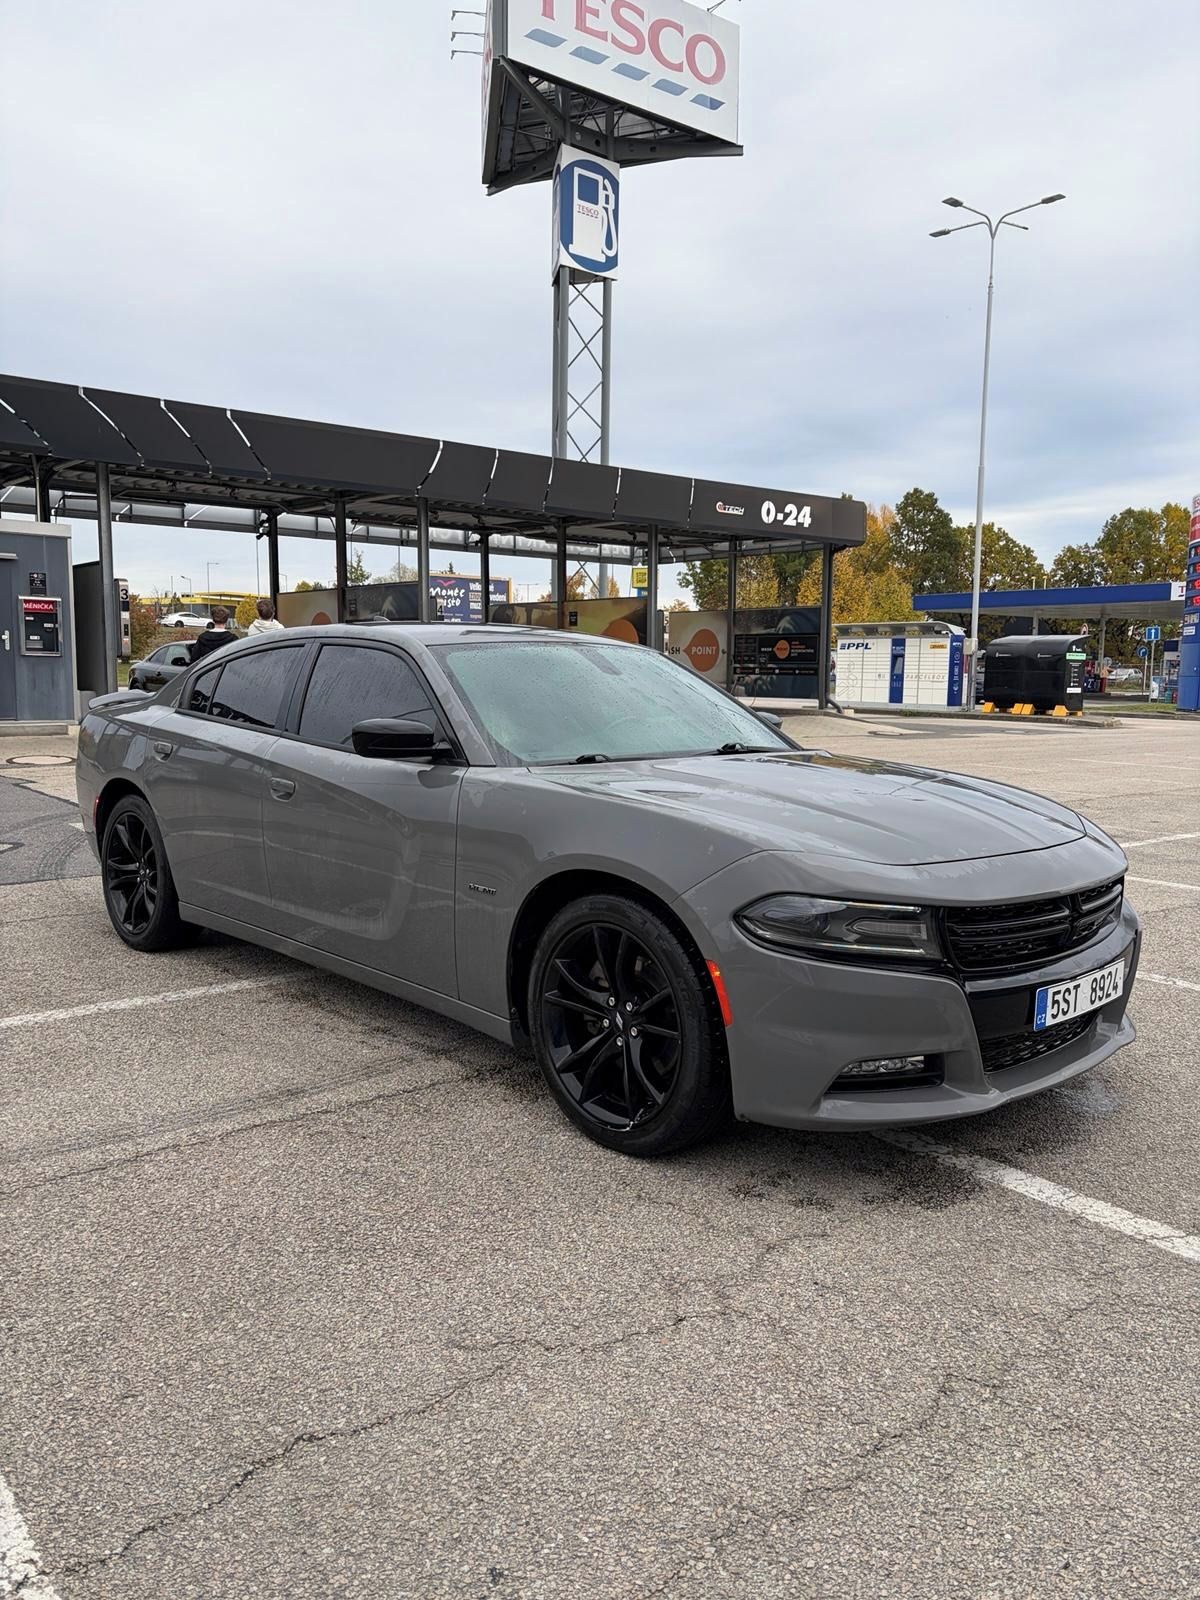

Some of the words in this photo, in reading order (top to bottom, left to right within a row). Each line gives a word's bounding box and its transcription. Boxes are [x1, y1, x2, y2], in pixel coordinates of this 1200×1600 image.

[577, 204, 599, 216] TESCO
[761, 501, 811, 528] 0-24
[121, 589, 128, 600] 3
[437, 605, 443, 613] 4
[691, 646, 718, 655] POINT
[847, 642, 872, 650] PPL
[1050, 983, 1081, 1019] 5ST
[1089, 967, 1119, 1005] 8924
[1036, 1013, 1046, 1024] CZ
